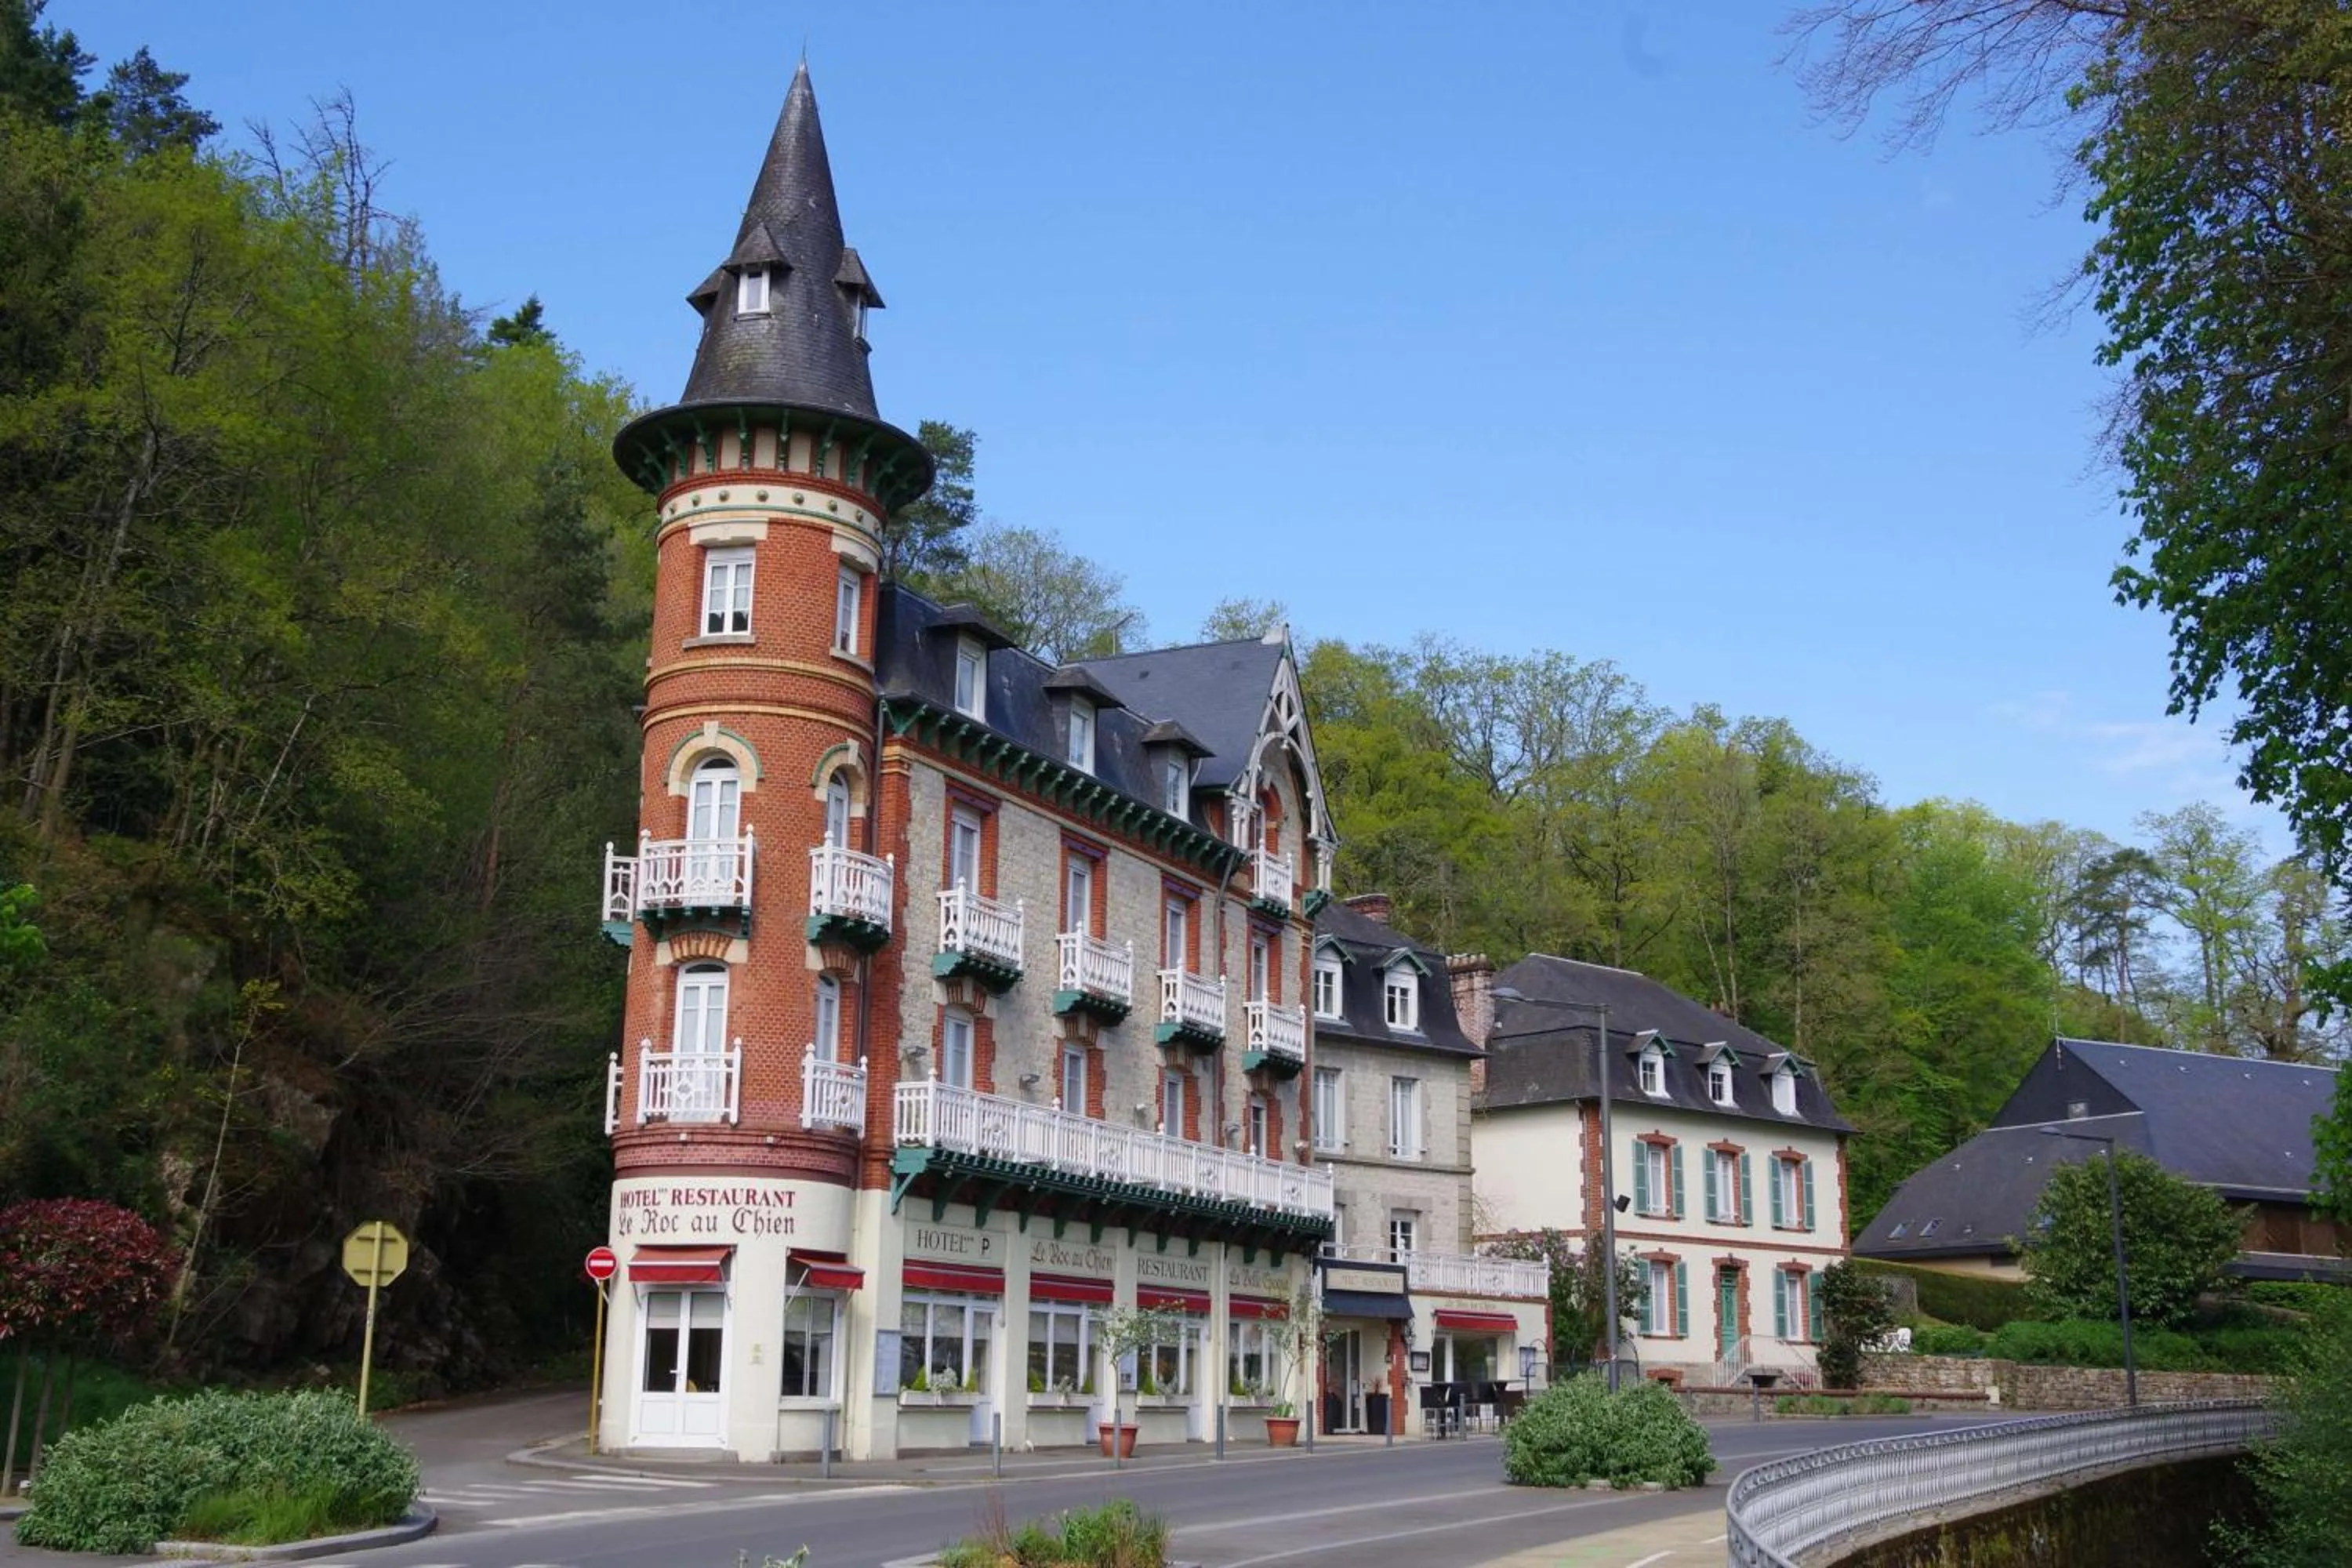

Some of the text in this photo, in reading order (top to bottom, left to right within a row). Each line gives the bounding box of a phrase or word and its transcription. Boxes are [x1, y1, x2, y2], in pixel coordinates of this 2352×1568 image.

[620, 1188, 796, 1208] HOTEL RESTAURANT
[619, 1207, 794, 1240] Le Roc au Chien
[917, 1229, 991, 1254] HOTEL P
[1138, 1257, 1209, 1282] RESTAURANT
